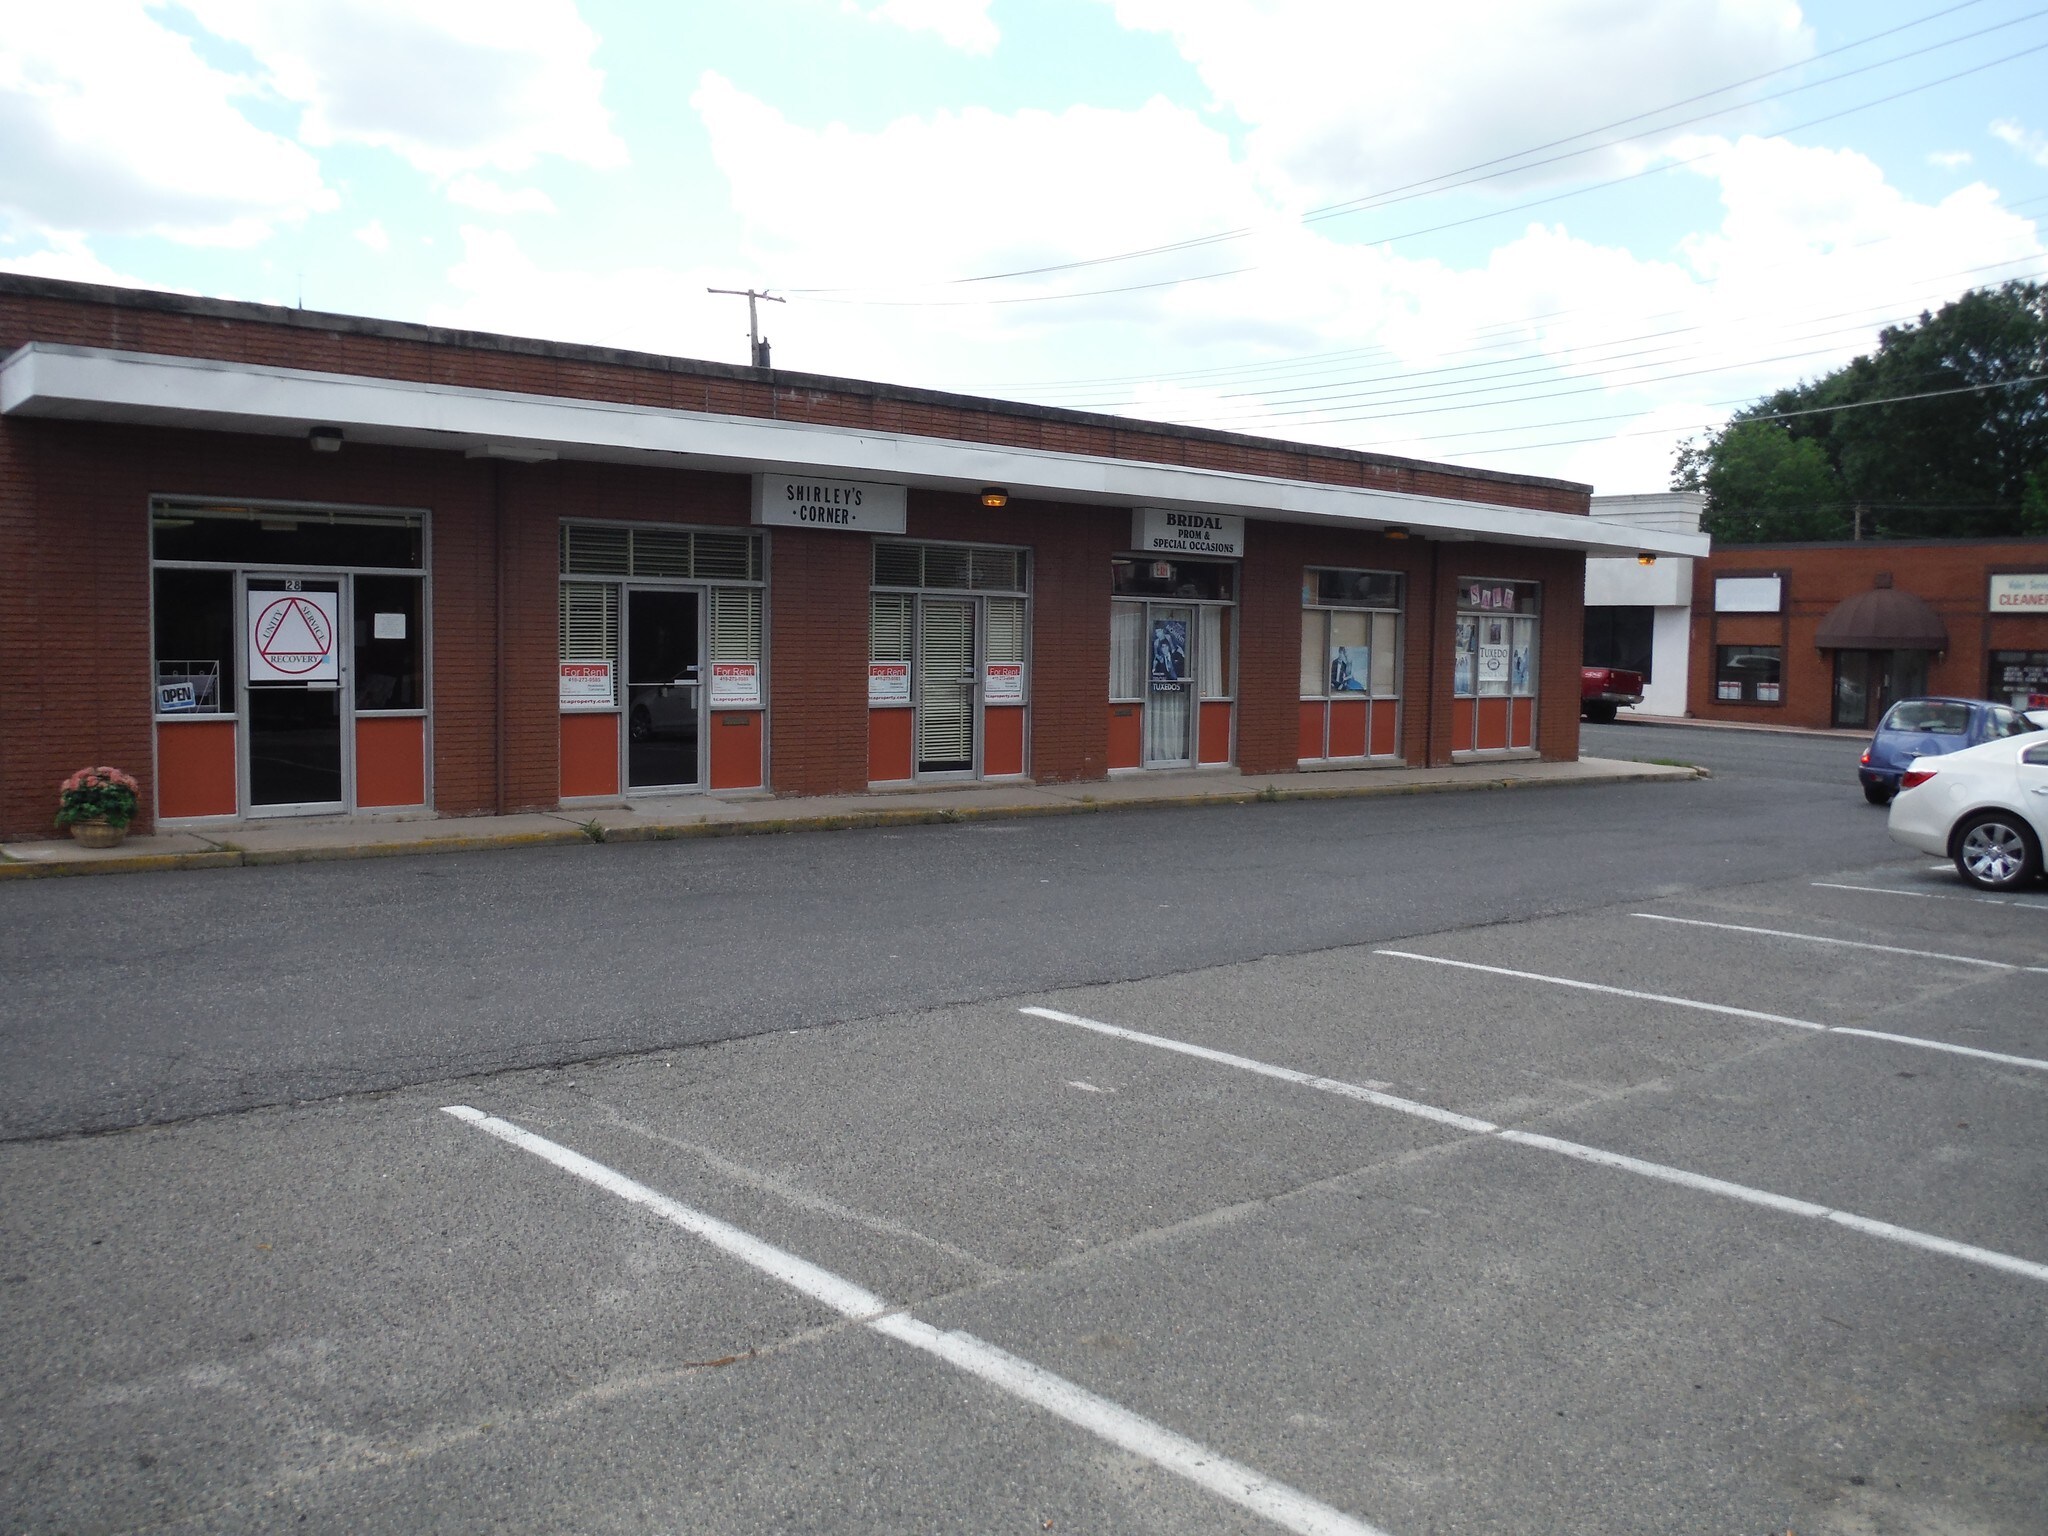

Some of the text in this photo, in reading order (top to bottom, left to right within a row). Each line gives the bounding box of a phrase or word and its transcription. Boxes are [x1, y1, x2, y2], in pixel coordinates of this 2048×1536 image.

[787, 484, 862, 505] SHIRLEY'S
[800, 505, 849, 524] CORNER
[1166, 513, 1222, 530] BRIDAL
[1178, 529, 1210, 541] PROM &
[1153, 538, 1234, 554] SPECIAL OCCASIONS
[286, 580, 302, 591] 28
[1471, 585, 1513, 607] SALE
[263, 608, 283, 639] UNITY
[301, 605, 326, 641] SERVICE
[1480, 647, 1508, 658] TUXEDO
[270, 655, 319, 664] RECOVERY
[564, 667, 605, 677] For Rent
[716, 667, 752, 677] For Rent
[872, 667, 905, 677] For Rent
[989, 667, 1018, 676] For Rent
[1153, 683, 1180, 691] TUXEDOS
[162, 687, 191, 703] OPEN
